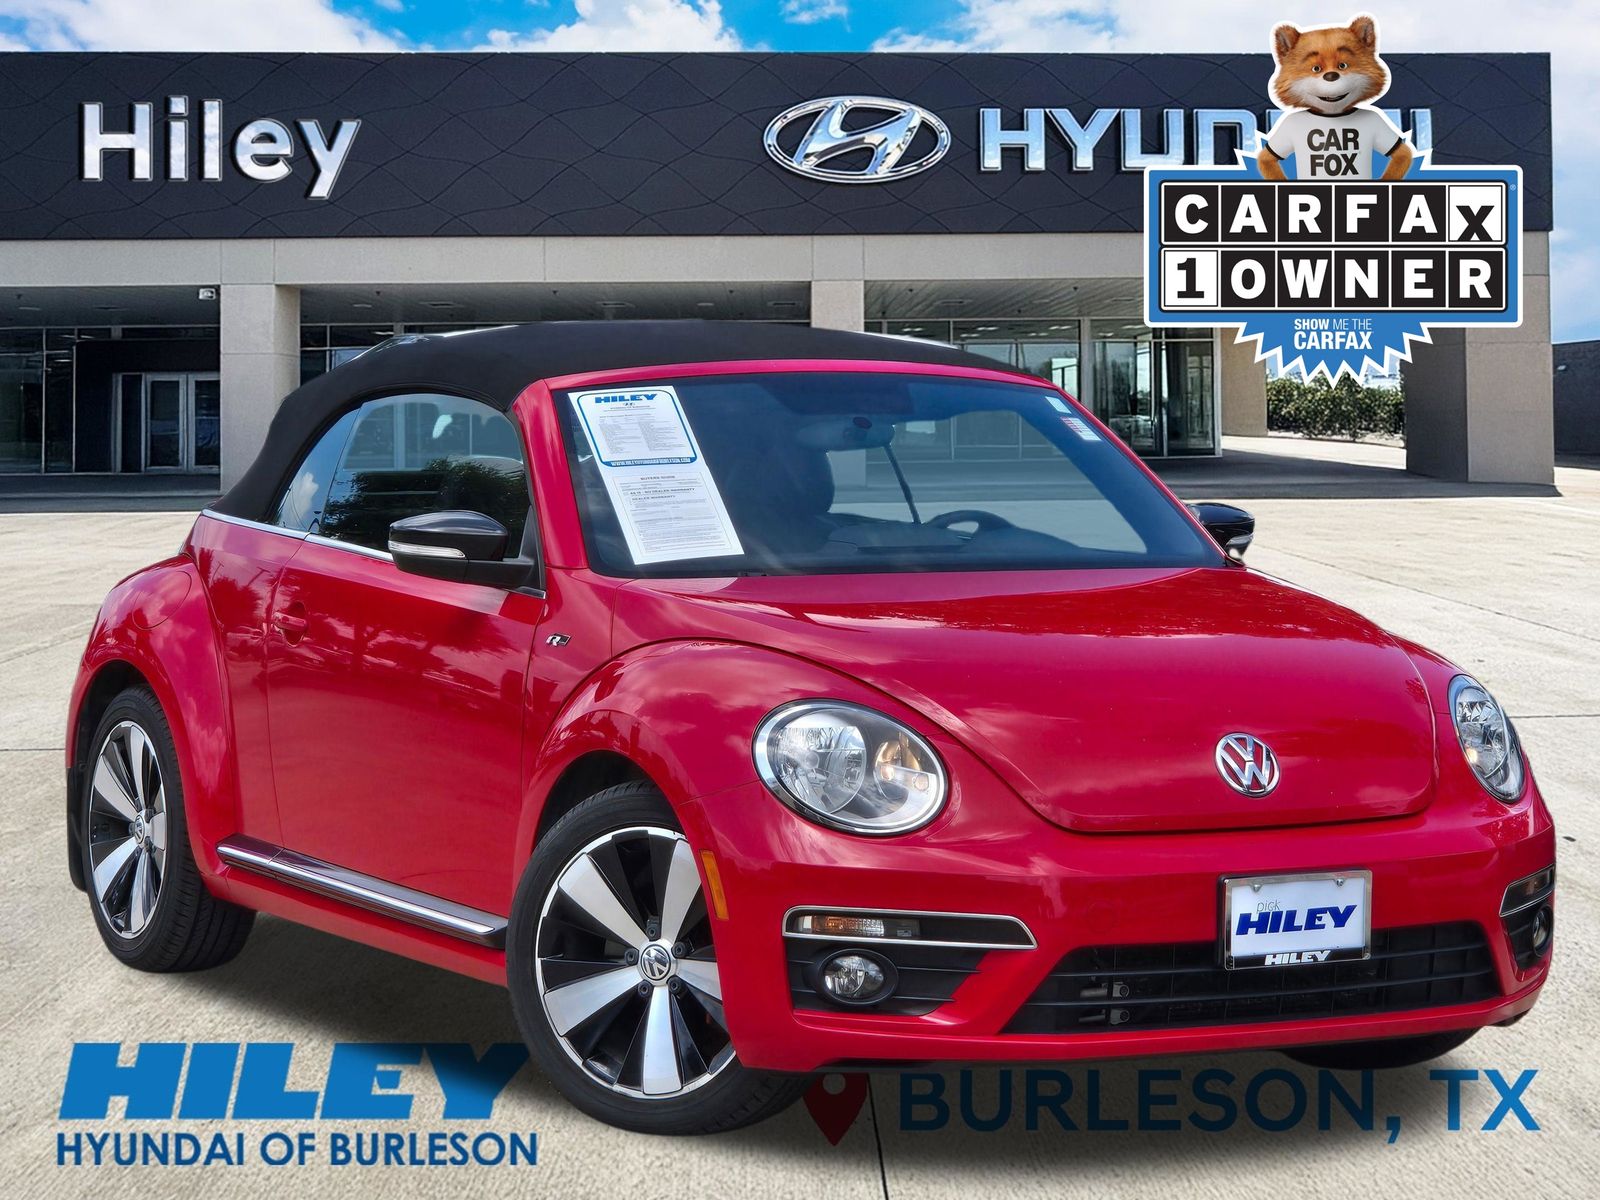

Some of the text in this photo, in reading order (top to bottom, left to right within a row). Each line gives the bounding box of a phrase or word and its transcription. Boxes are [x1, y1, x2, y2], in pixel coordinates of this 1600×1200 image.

[80, 95, 362, 200] Hiley
[979, 107, 1432, 171] HYUNI
[594, 393, 658, 404] HILEY
[1256, 898, 1282, 912] pick
[1235, 904, 1357, 936] HILEY
[1264, 950, 1331, 966] HILEY
